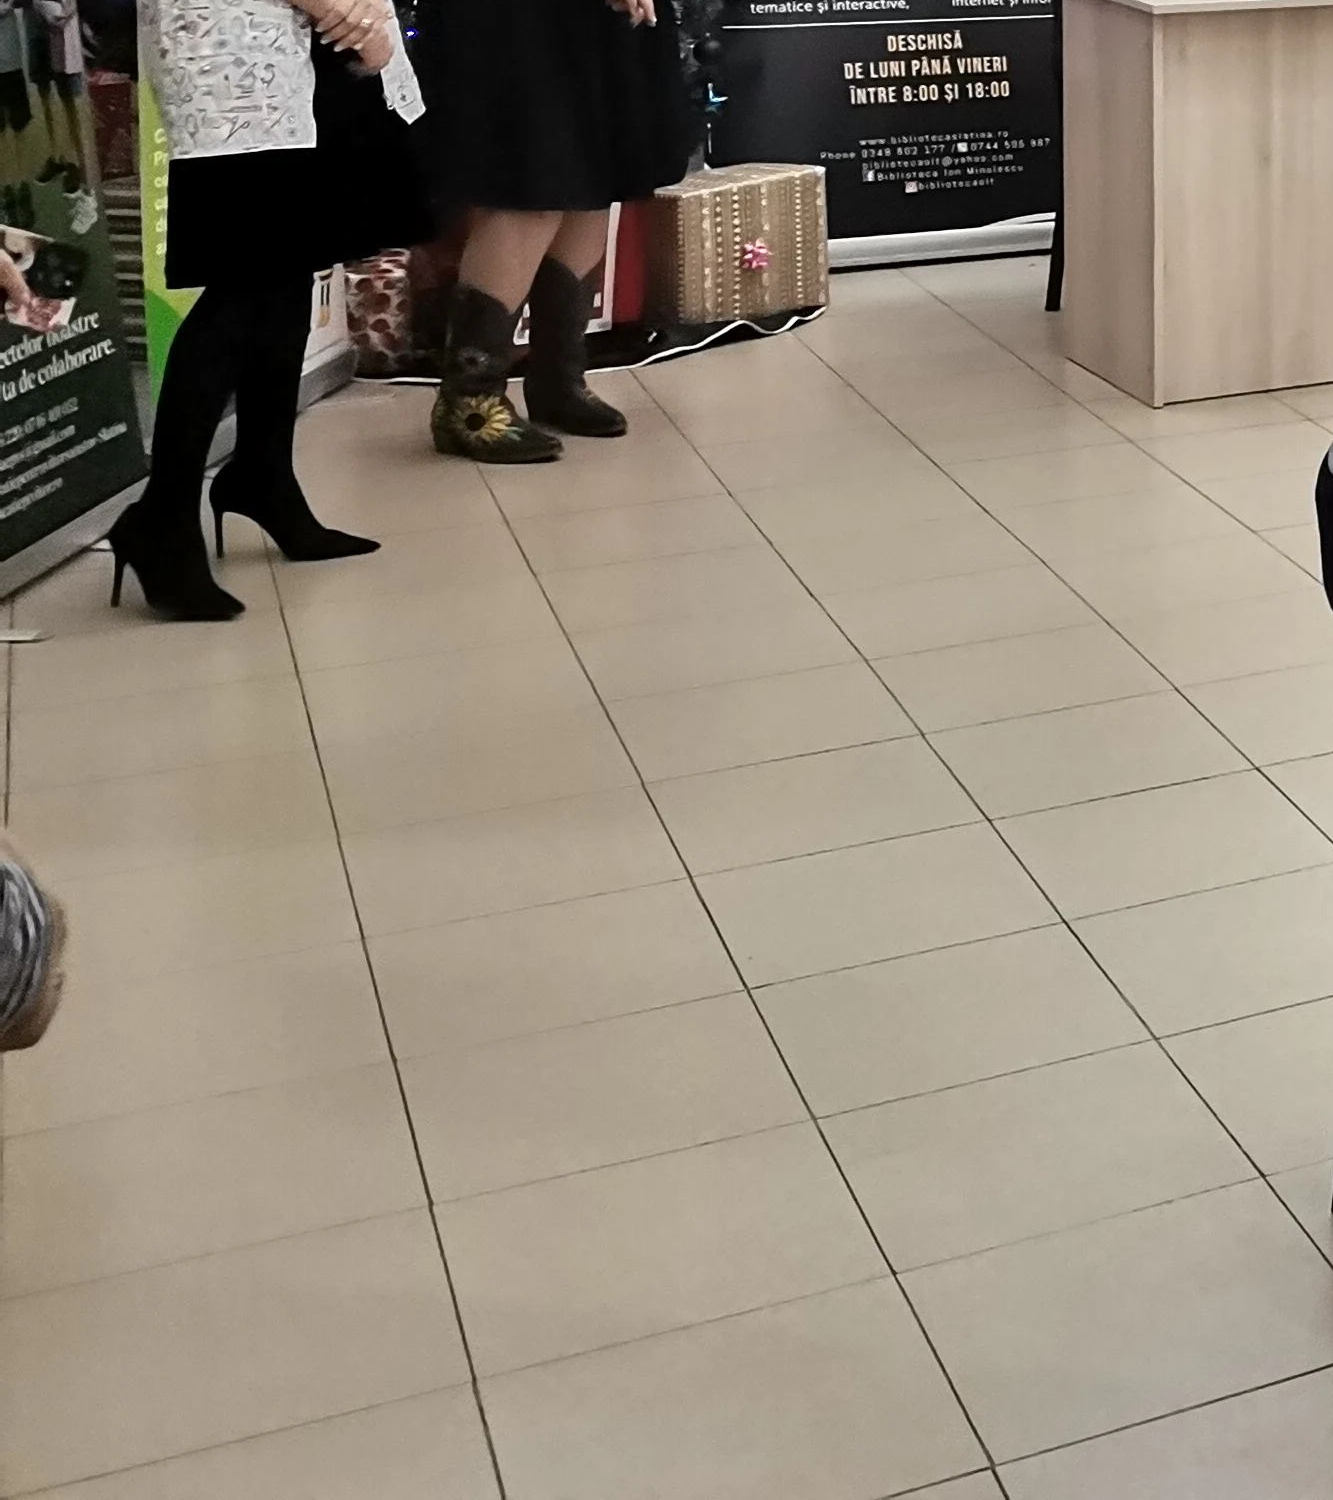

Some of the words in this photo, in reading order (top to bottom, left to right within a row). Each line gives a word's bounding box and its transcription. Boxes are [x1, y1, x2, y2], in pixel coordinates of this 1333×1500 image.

[750, 0, 814, 14] tematice
[817, 0, 829, 14] și
[887, 29, 963, 52] DESCHISĂ
[843, 62, 865, 80] DE
[869, 60, 905, 78] LUNI
[911, 55, 952, 77] PÂNĂ
[957, 56, 1007, 74] VINERI
[850, 85, 897, 105] ÎNTRE
[903, 84, 939, 102] 8:00
[944, 83, 959, 103] ȘI
[965, 81, 1010, 98] 18:00
[19, 368, 37, 394] de
